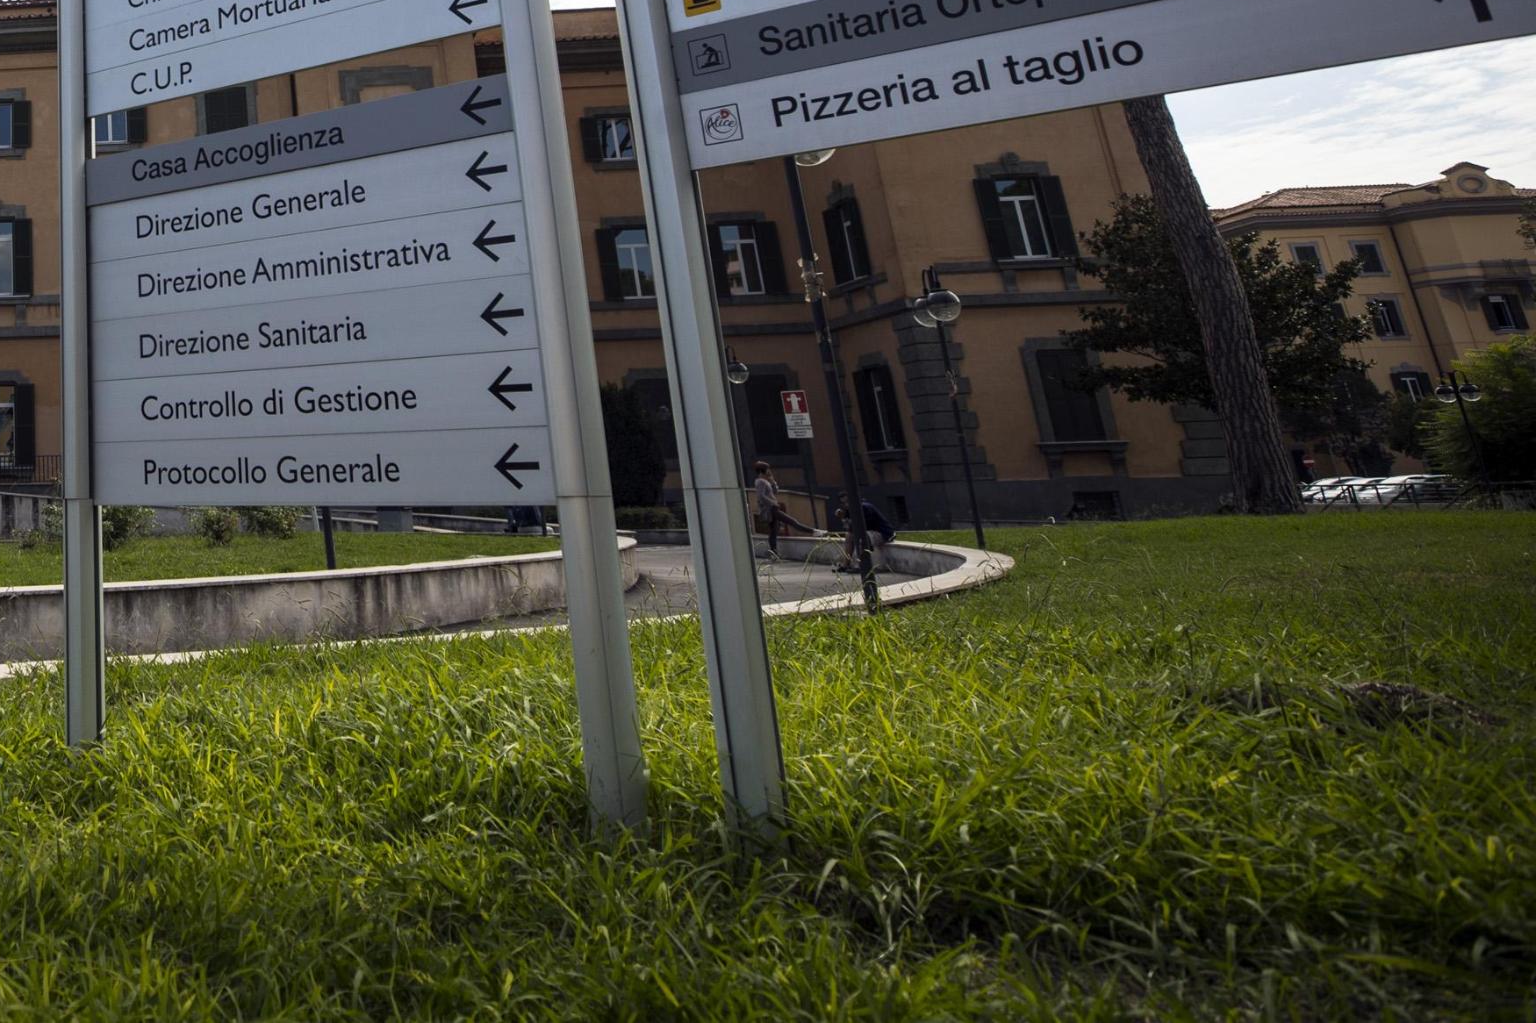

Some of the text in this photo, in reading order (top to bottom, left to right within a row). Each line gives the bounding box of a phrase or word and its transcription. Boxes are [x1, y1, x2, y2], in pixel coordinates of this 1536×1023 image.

[128, 17, 212, 52] Camera
[758, 0, 928, 56] Sanitaria
[130, 61, 193, 96] C.U.P.
[770, 36, 1144, 128] Pizzeria al taglio
[131, 126, 345, 182] Casa Accoglienza
[135, 179, 366, 240] Direzione Generale
[137, 238, 452, 298] Direzione Amministrativa
[139, 315, 368, 359] Direzione Sanitaria
[140, 384, 417, 421] Controllo di Gestione
[143, 453, 401, 486] Protocollo Generale
